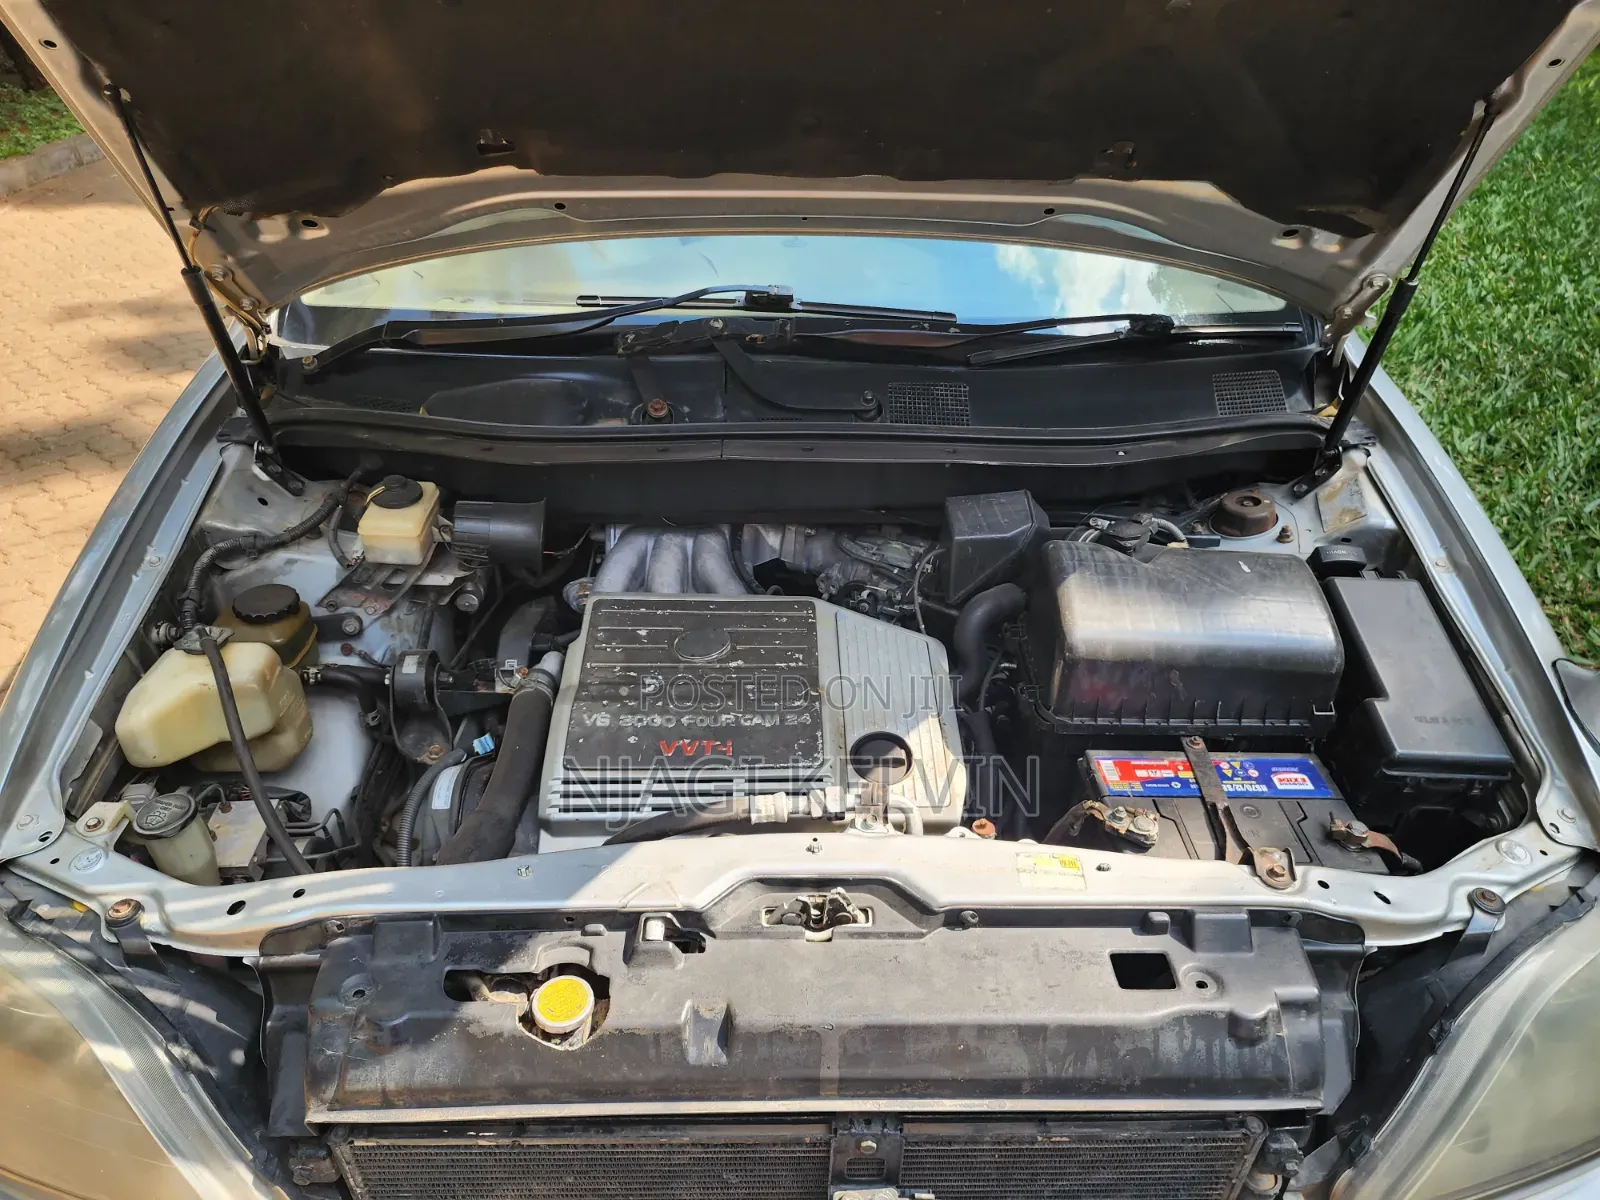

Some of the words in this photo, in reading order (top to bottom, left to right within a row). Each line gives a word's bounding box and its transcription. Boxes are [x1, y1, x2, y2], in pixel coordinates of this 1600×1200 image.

[583, 713, 611, 727] V6
[618, 714, 677, 728] 3000
[681, 713, 736, 728] FOUR
[741, 713, 780, 727] CAM
[785, 712, 813, 726] 24
[659, 740, 733, 756] VVT-i
